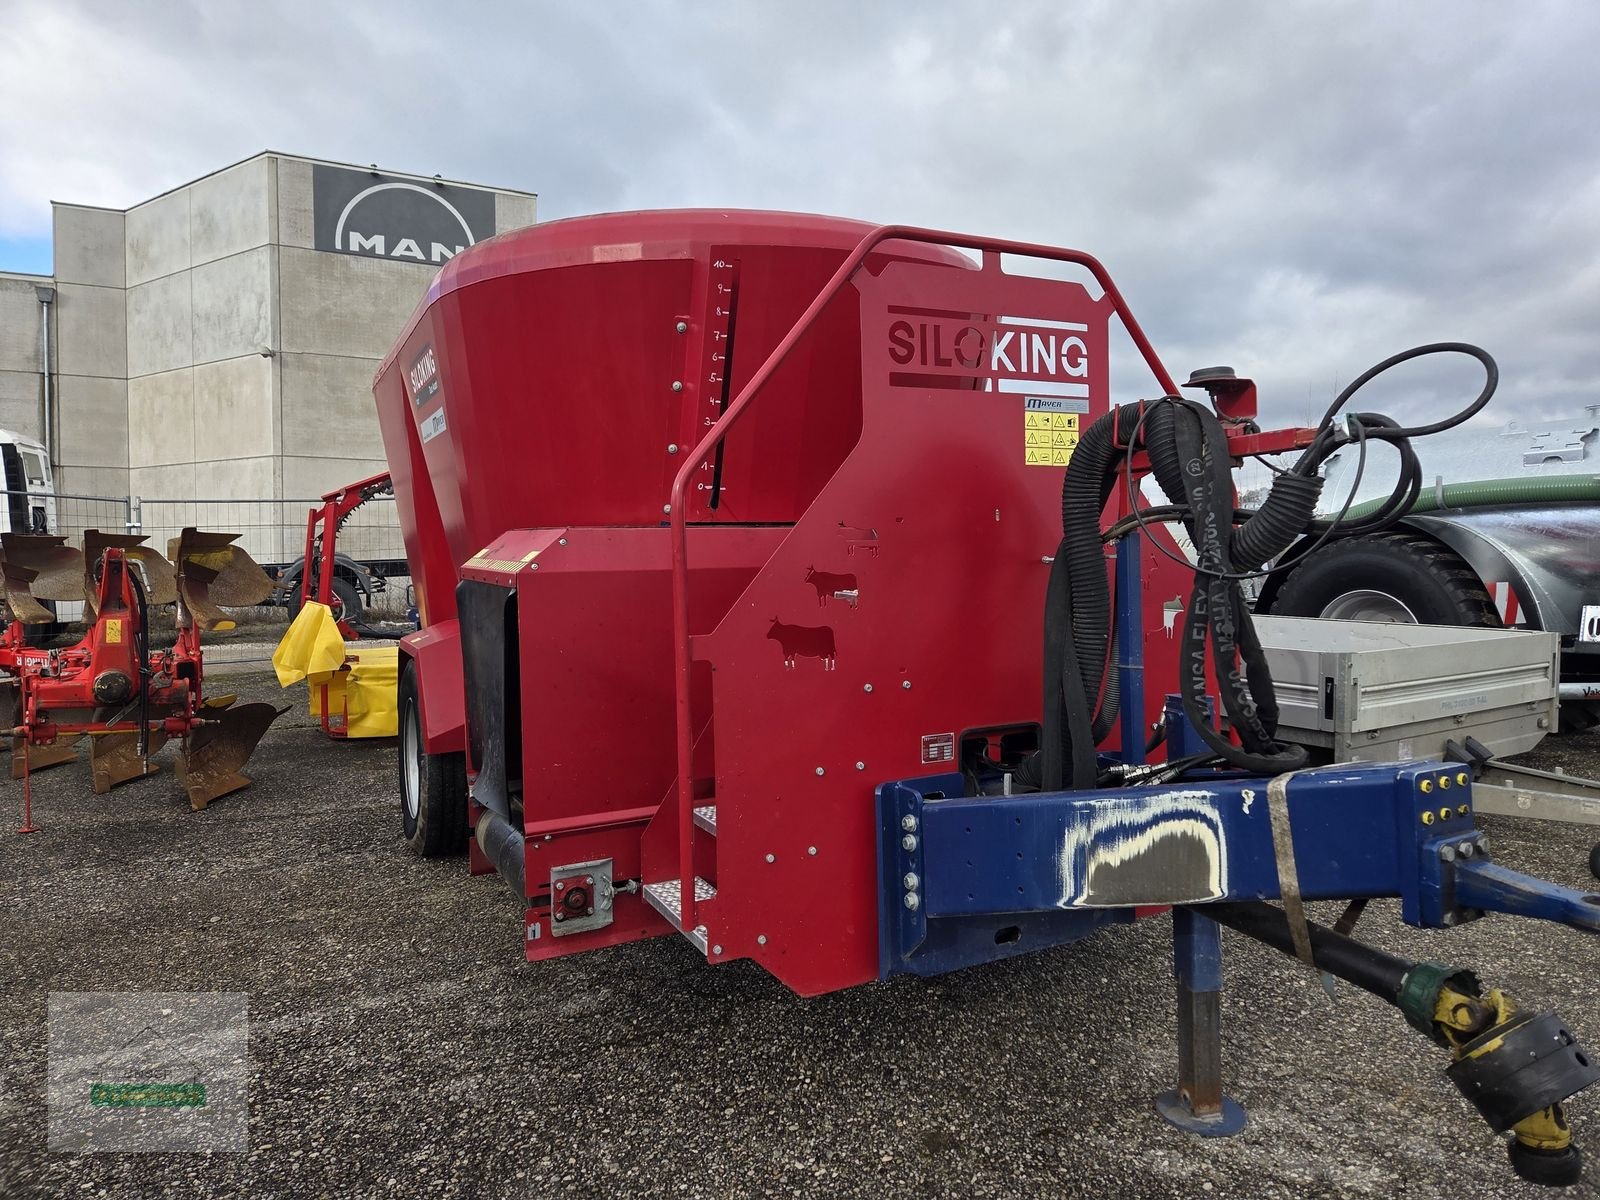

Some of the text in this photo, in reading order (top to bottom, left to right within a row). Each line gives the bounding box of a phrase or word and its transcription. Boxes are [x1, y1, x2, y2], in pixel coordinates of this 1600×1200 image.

[349, 231, 464, 262] MAN
[713, 260, 725, 269] 10
[717, 283, 723, 294] 9
[716, 306, 722, 316] 8
[713, 330, 720, 341] 7
[888, 320, 1088, 378] SILOKING
[712, 352, 718, 361] 6
[709, 372, 717, 383] 5
[709, 397, 715, 406] 4
[1027, 398, 1063, 409] MAYER
[704, 416, 711, 426] 3
[701, 461, 708, 471] 1
[697, 482, 704, 491] 0
